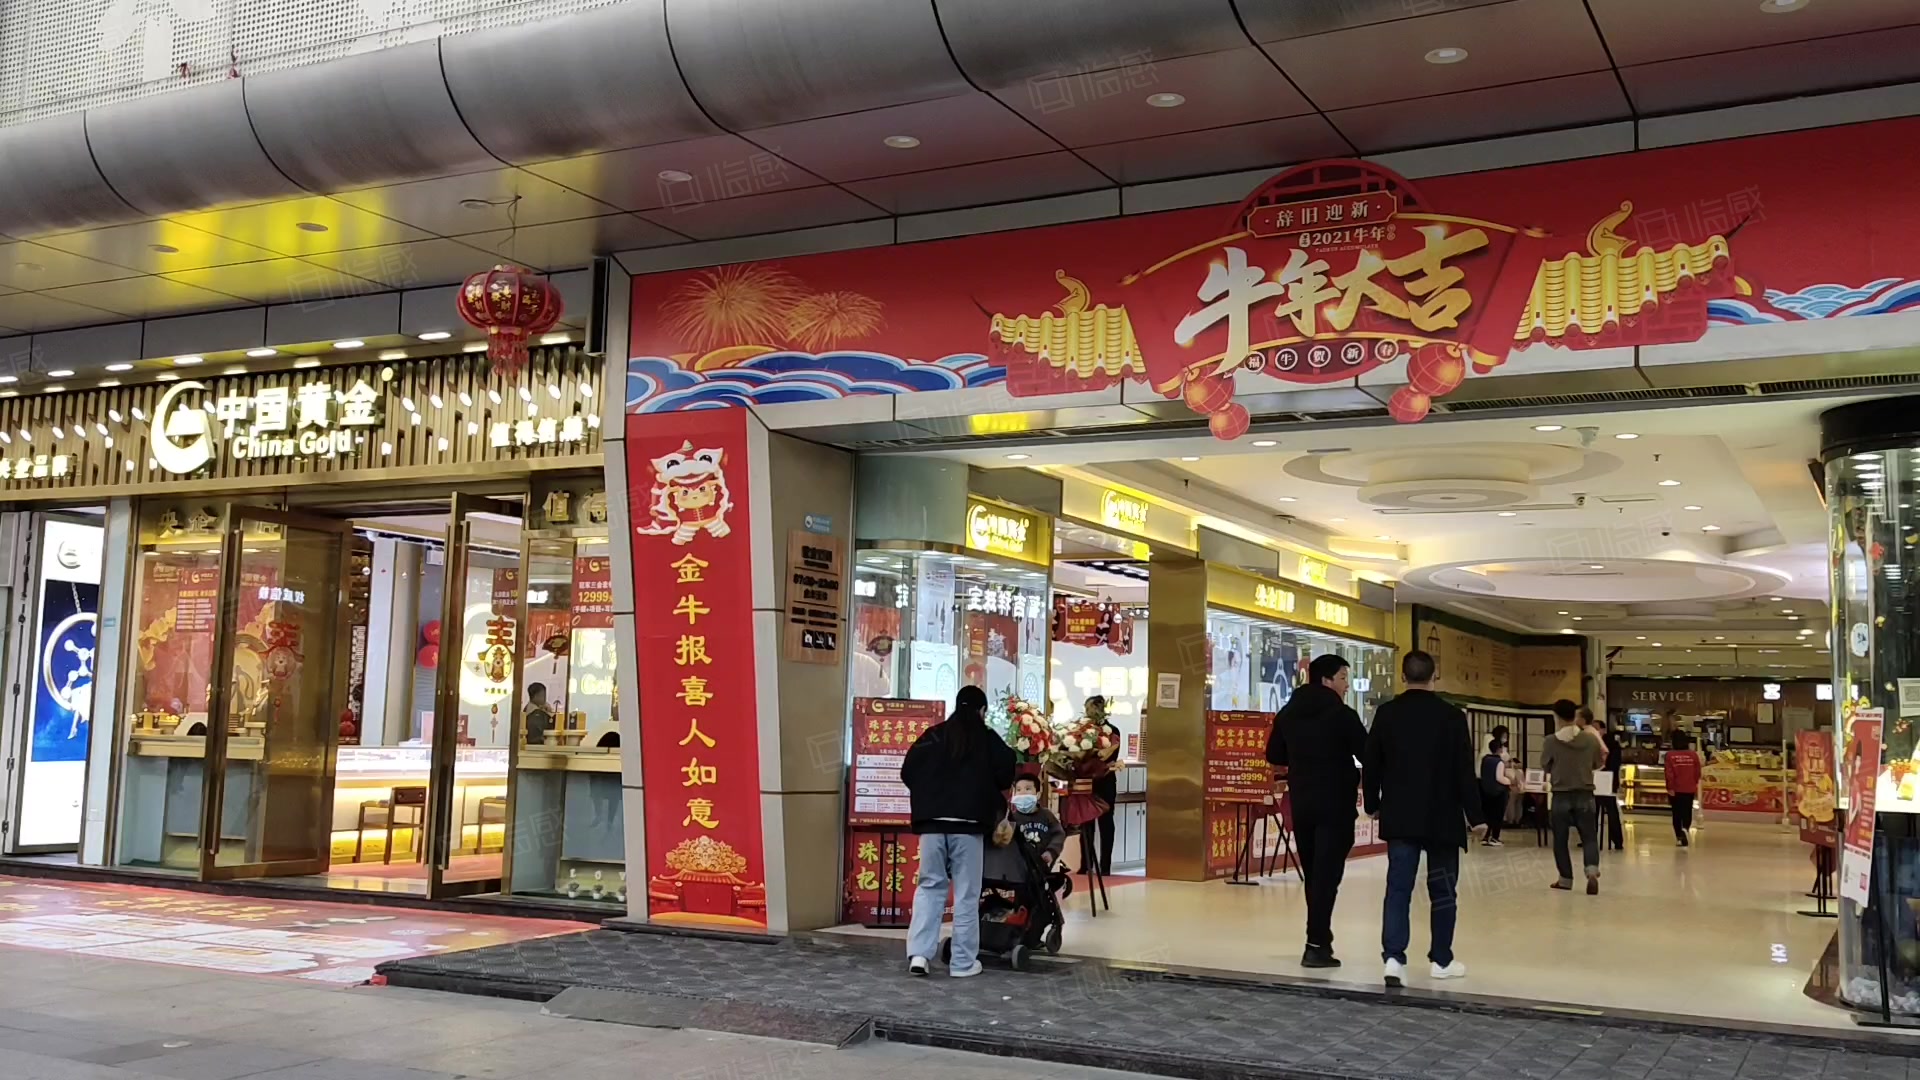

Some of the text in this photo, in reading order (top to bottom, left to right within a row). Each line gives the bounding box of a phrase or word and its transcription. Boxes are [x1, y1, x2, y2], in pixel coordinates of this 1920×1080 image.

[1276, 200, 1369, 228] 辞旧迎新
[1174, 225, 1491, 377] 牛年大吉
[215, 379, 382, 438] 中国黄金
[232, 429, 351, 458] China Gold
[669, 551, 721, 830] 金牛报喜人如意
[1631, 690, 1695, 702] SERVICE
